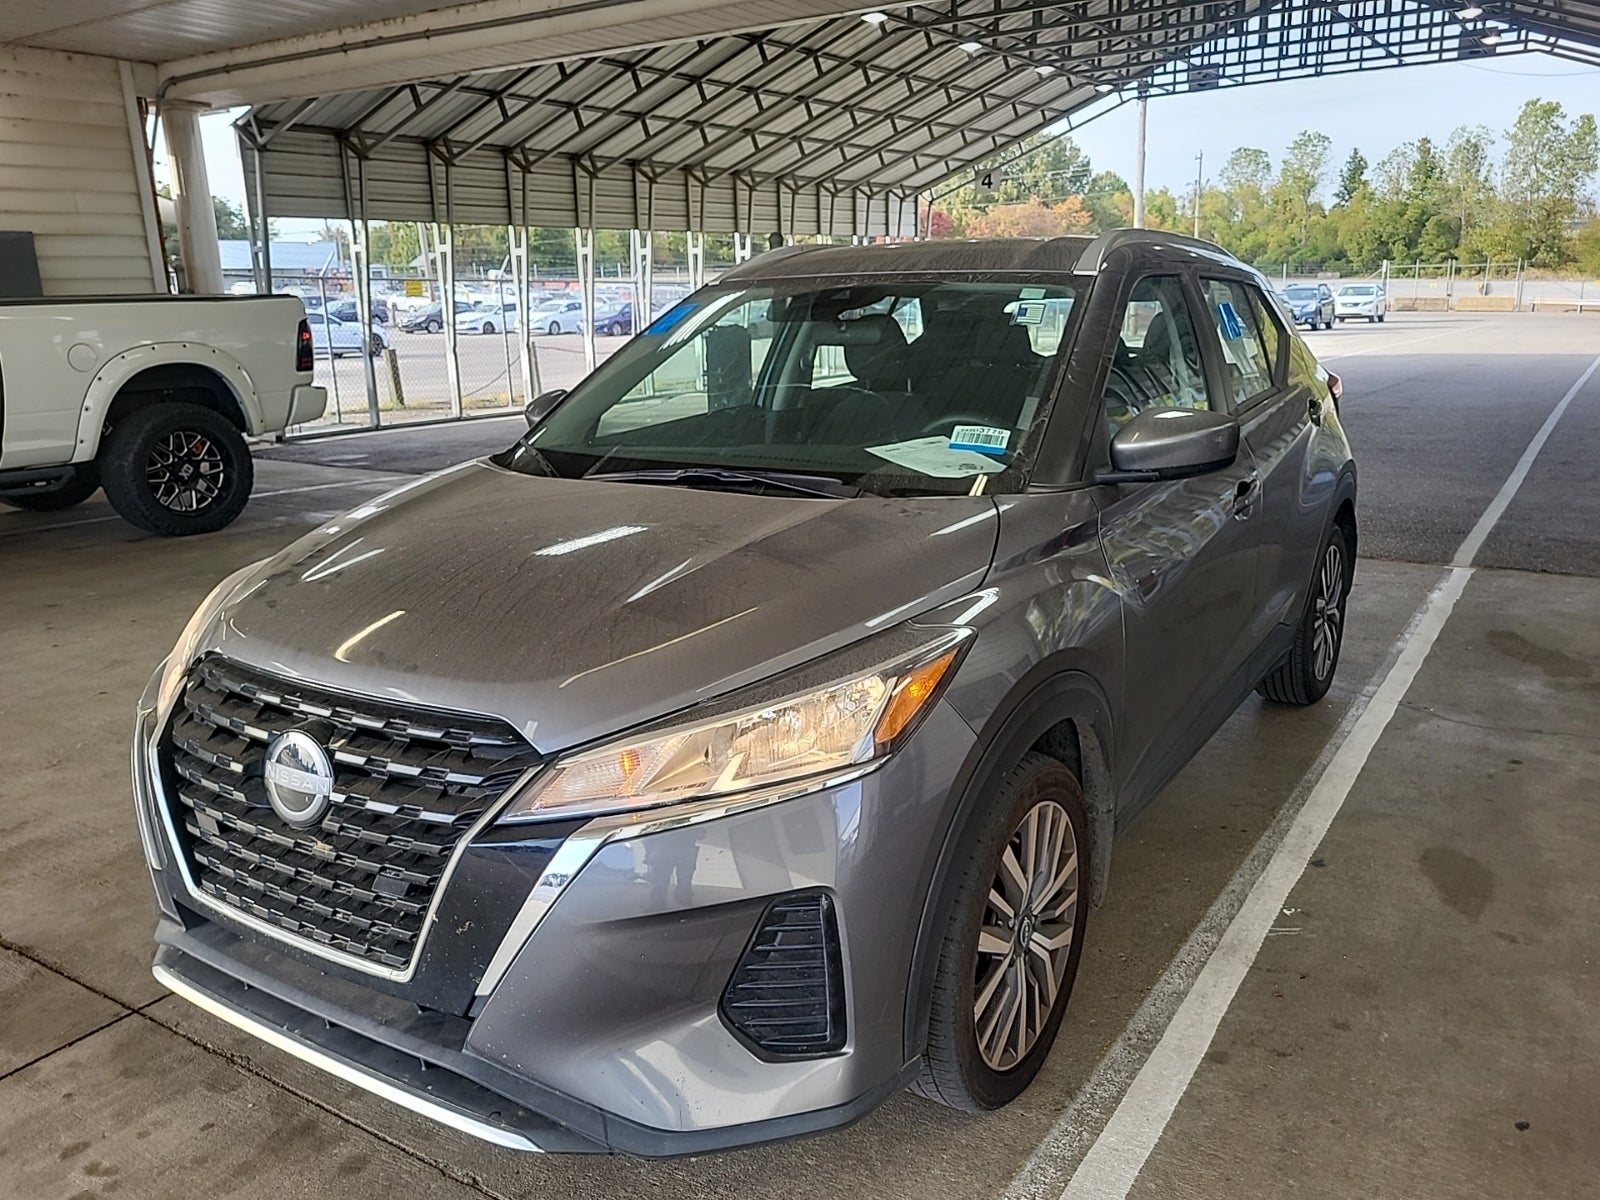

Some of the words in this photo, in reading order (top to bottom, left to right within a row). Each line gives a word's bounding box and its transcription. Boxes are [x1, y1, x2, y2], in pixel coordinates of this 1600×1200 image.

[981, 173, 993, 189] 4
[178, 463, 194, 480] XD
[265, 763, 328, 793] NISSAN
